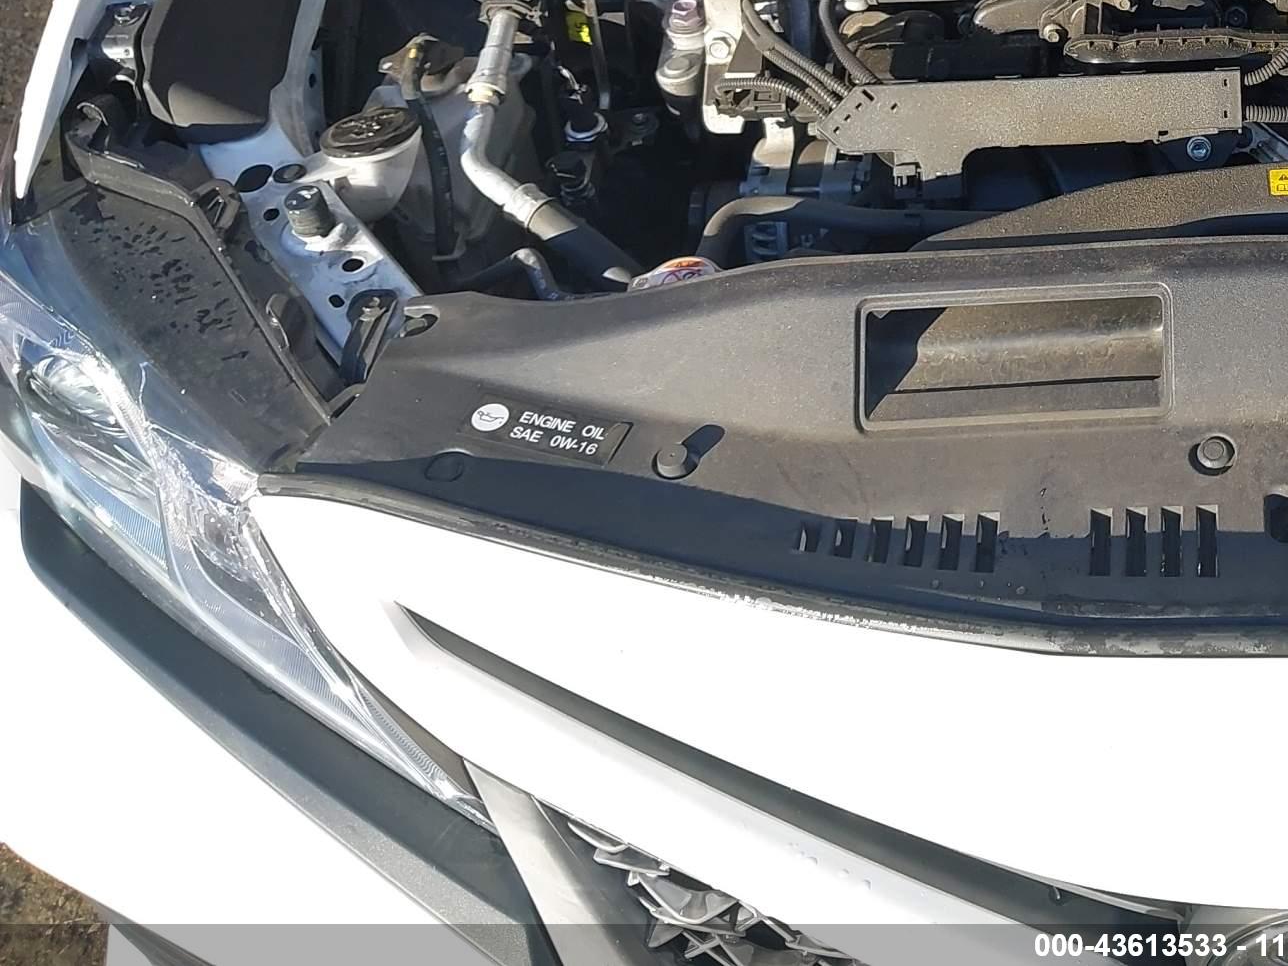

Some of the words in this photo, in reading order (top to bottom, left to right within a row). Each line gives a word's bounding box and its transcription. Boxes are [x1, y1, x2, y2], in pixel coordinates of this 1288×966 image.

[519, 411, 576, 433] ENGINE
[581, 425, 605, 440] OIL
[509, 426, 544, 443] SAE
[549, 435, 599, 455] 0W-16
